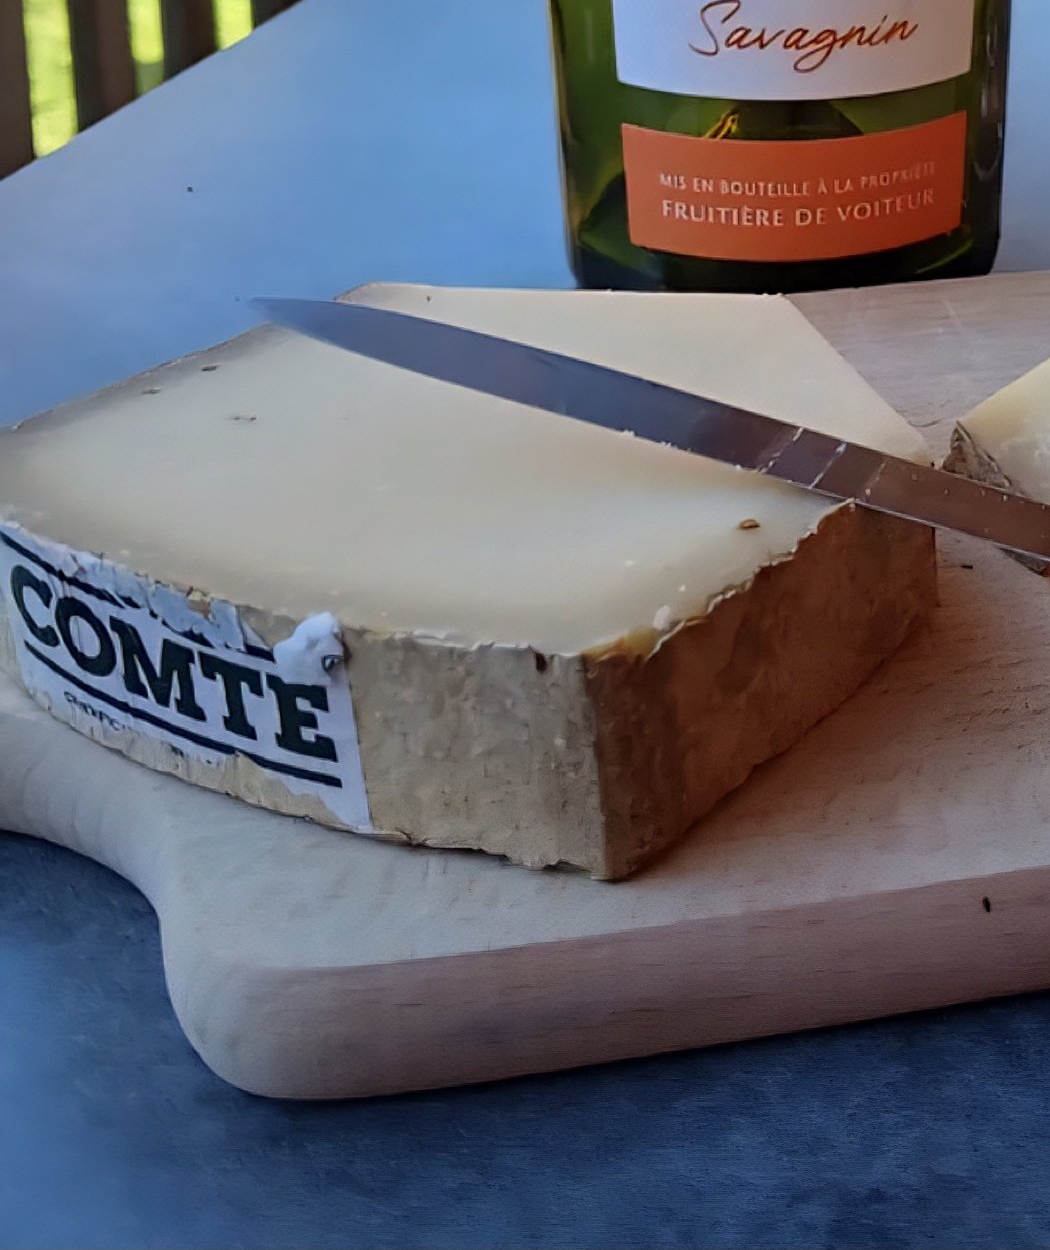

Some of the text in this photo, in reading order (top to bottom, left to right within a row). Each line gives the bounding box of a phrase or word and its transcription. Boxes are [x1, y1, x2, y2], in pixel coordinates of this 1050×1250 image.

[659, 172, 686, 190] MIS
[692, 177, 714, 194] EN
[720, 179, 810, 197] BOUTEILLE
[834, 176, 853, 193] LA
[662, 187, 935, 227] FRUITIÈRE DE VOITEUR
